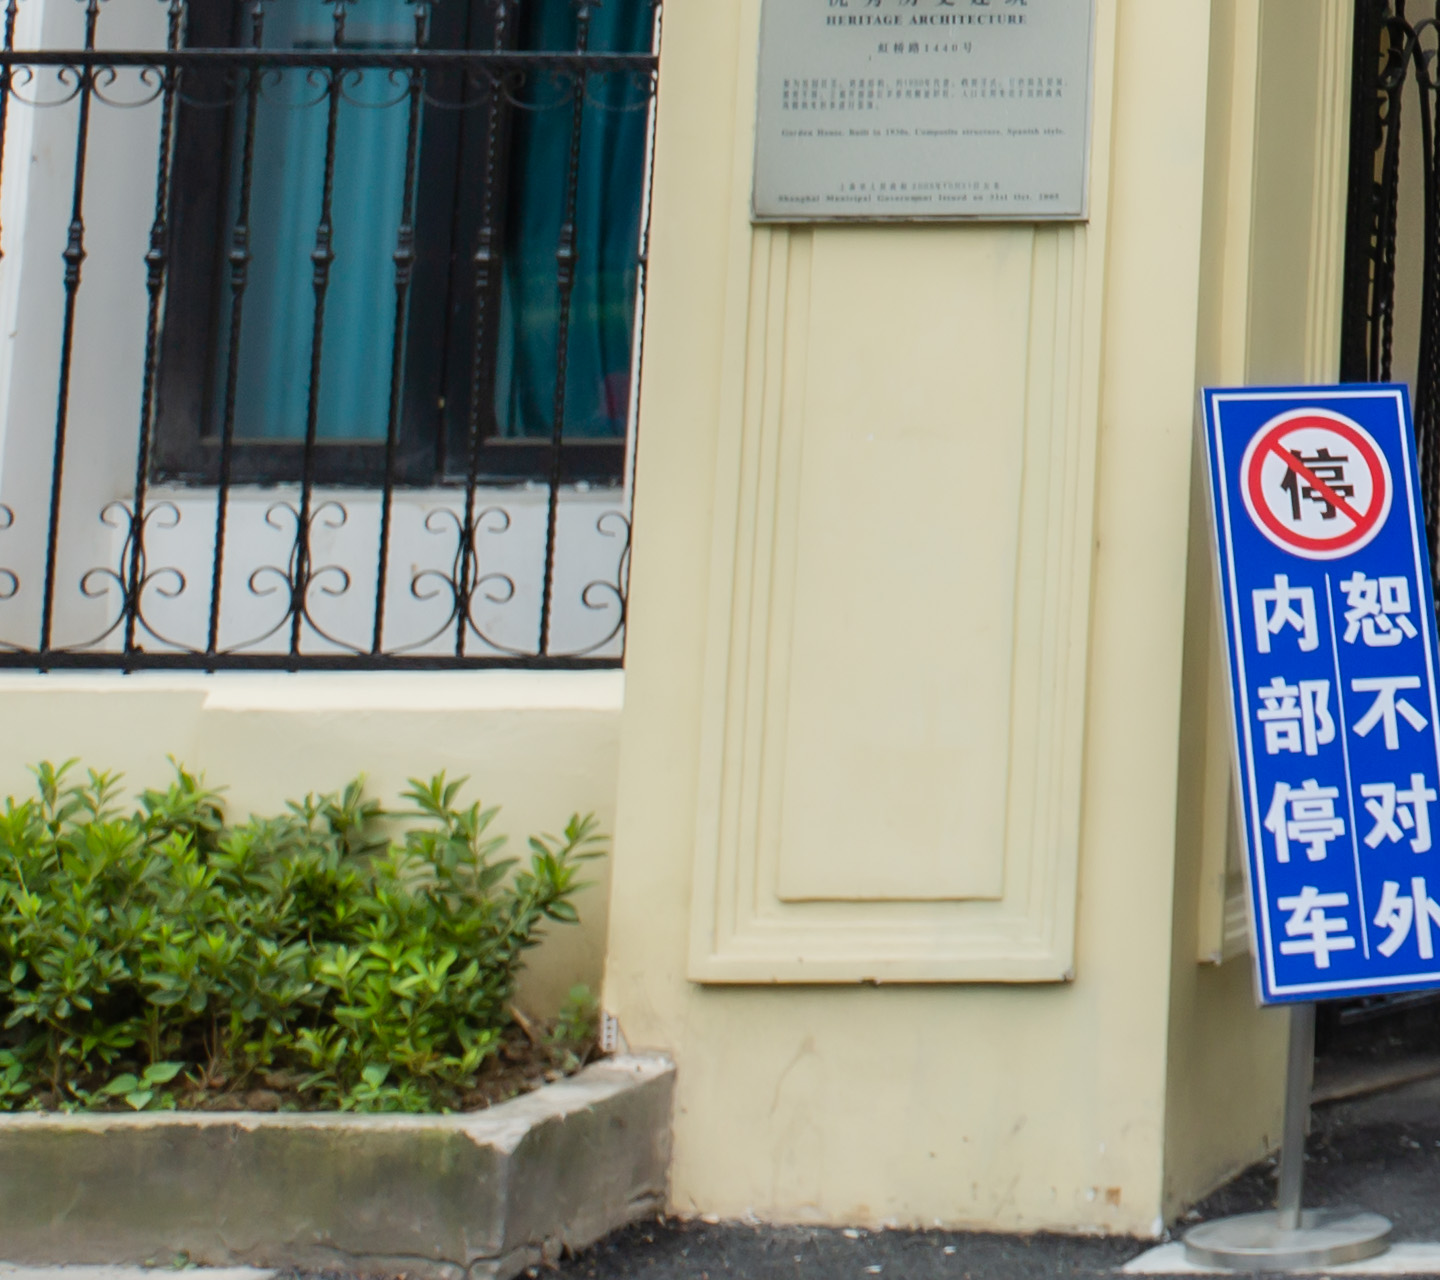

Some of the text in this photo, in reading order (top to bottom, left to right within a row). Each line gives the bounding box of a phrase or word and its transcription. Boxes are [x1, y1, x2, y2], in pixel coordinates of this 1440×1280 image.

[826, 14, 1027, 26] HERITAGE ARCHITECTURE
[1280, 447, 1355, 522] 停
[1252, 573, 1356, 969] 内部停车
